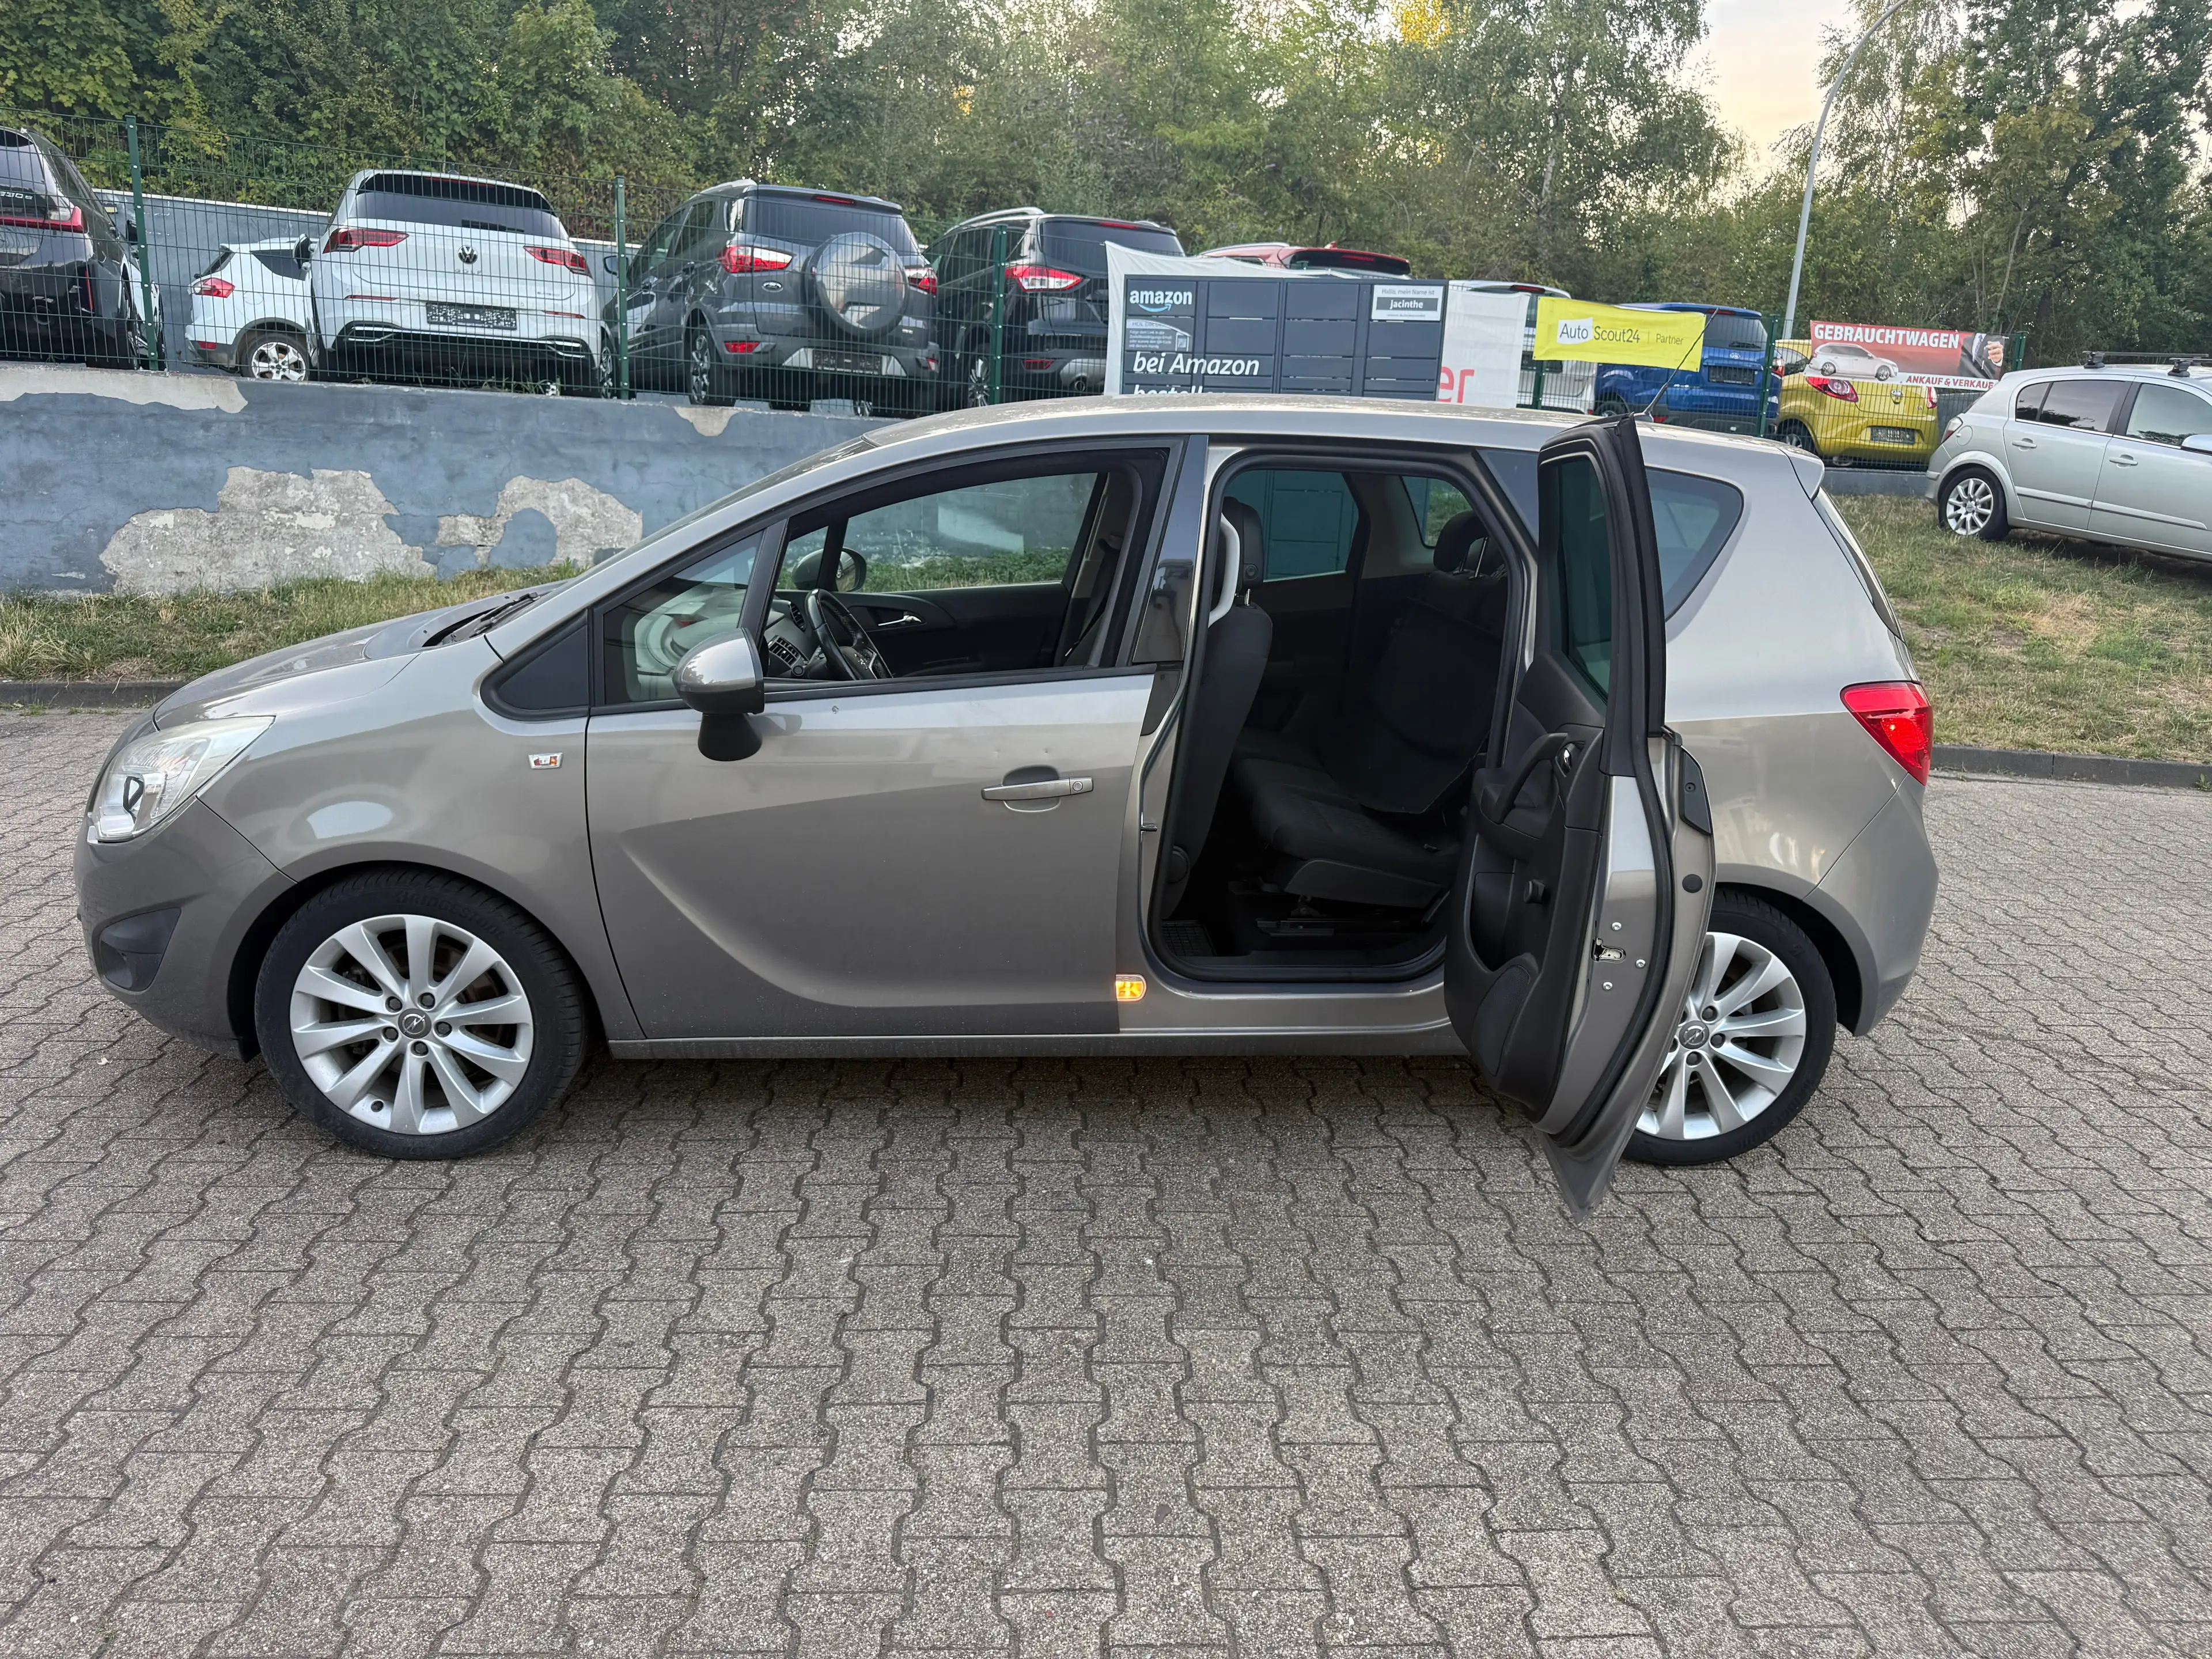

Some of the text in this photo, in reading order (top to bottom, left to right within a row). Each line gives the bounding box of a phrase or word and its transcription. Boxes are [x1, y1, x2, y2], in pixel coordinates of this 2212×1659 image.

[1130, 290, 1192, 305] amazon
[1389, 300, 1423, 309] Jacinthe
[1559, 323, 1684, 345] Auto Scout24 Partner
[1815, 324, 1959, 349] GEBRAUCHTWAGEN
[1133, 351, 1260, 376] bei Amazon
[1906, 376, 1944, 385] ANKAUF
[1944, 378, 1950, 387] &
